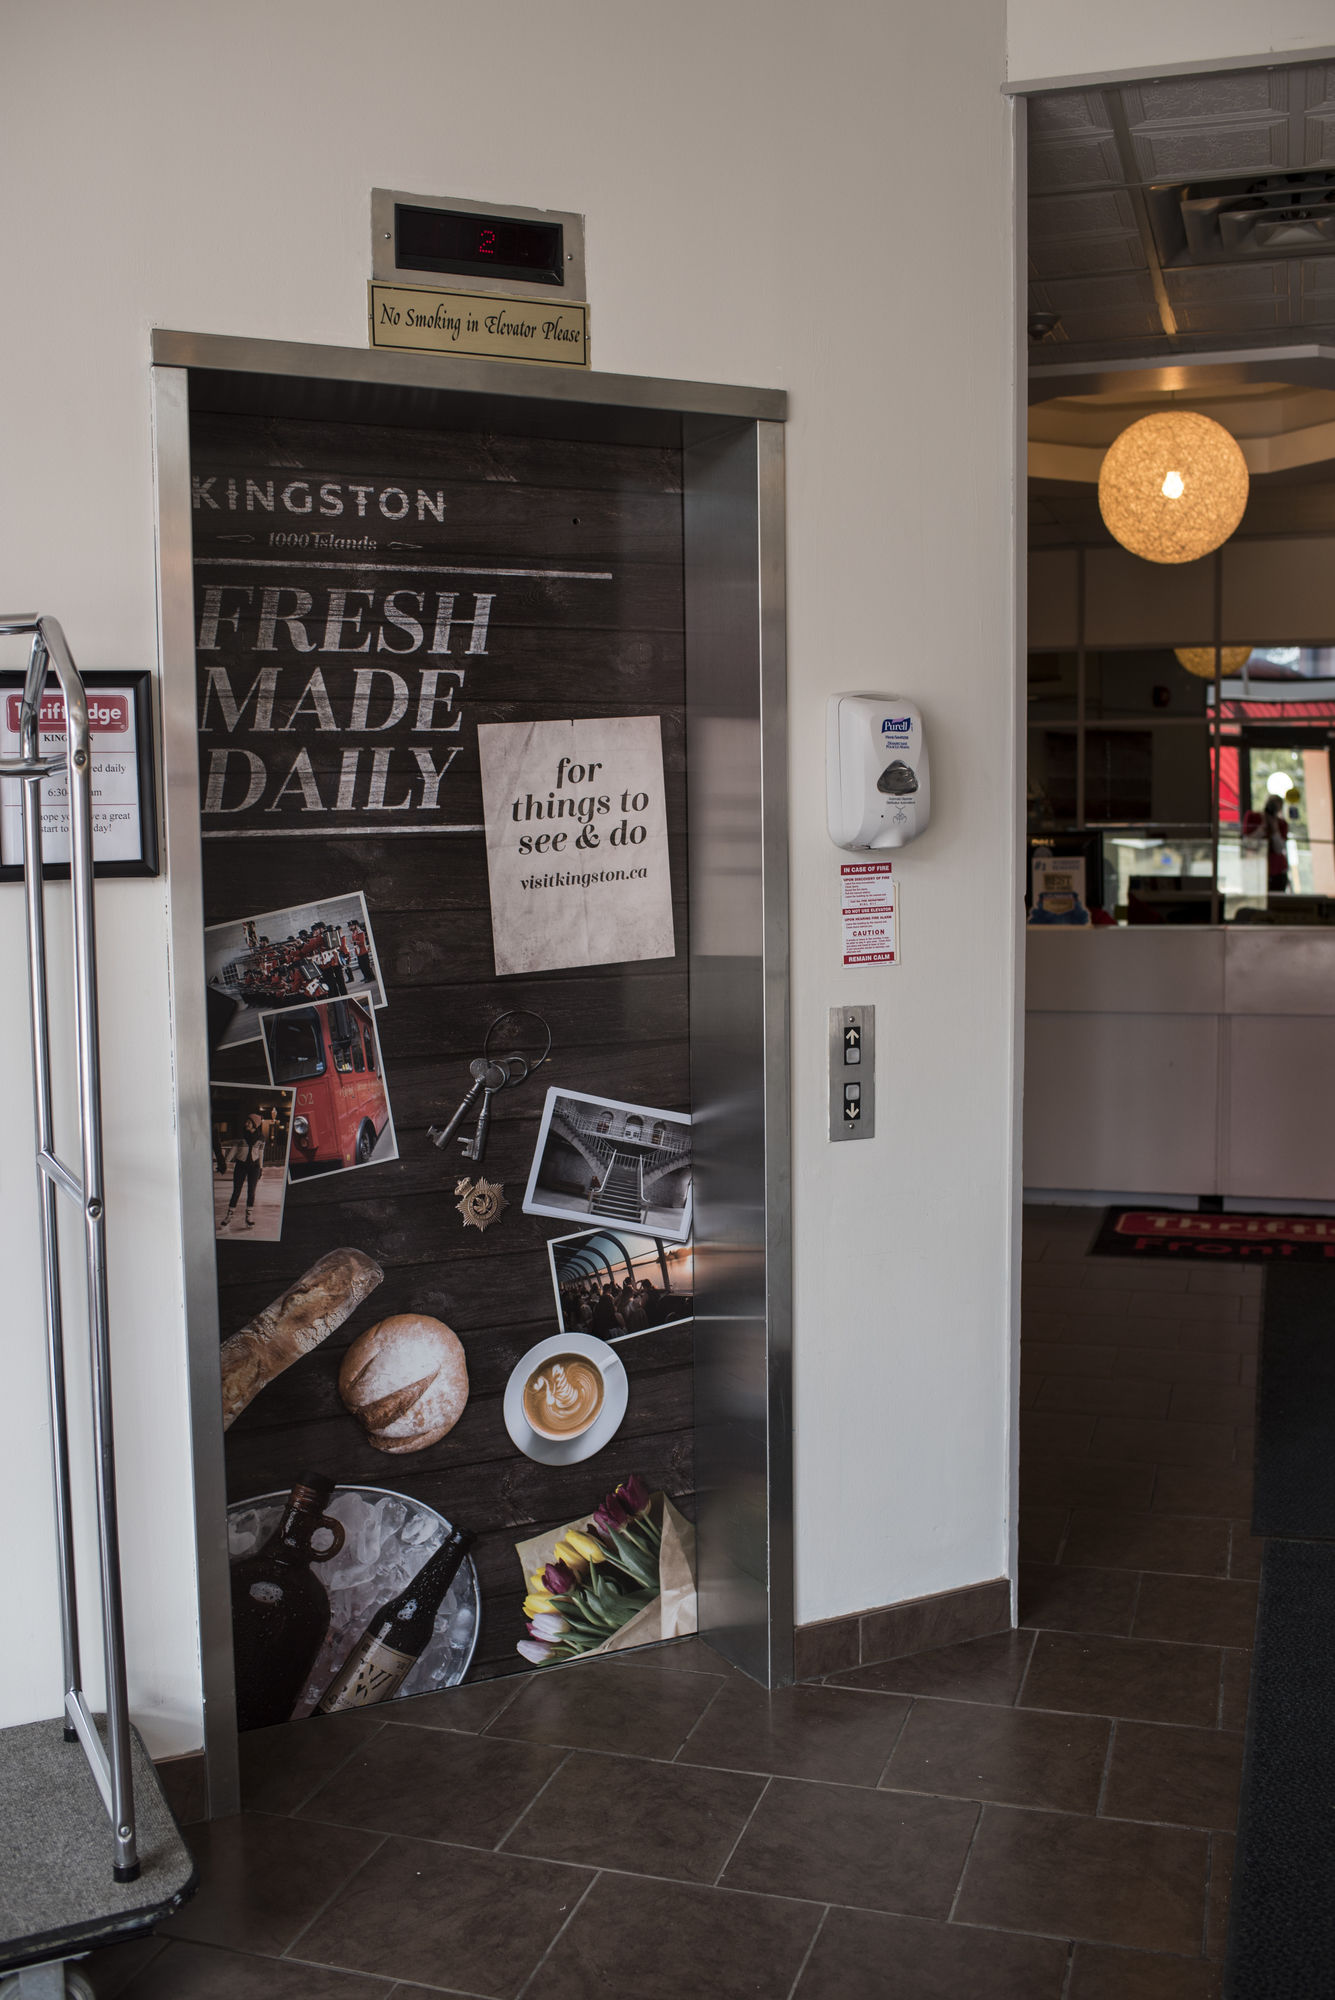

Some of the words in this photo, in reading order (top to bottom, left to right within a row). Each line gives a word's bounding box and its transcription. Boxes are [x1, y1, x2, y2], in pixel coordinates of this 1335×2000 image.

[479, 229, 495, 254] 2
[380, 303, 401, 326] No
[405, 303, 461, 341] Smoking
[466, 312, 479, 332] in
[484, 310, 537, 338] Elevator
[541, 316, 580, 343] Please
[192, 476, 446, 522] KINGSTON
[268, 532, 309, 548] 1000
[312, 532, 377, 551] Islands
[195, 585, 496, 655] FRESH
[198, 666, 465, 732] MADE
[884, 721, 908, 731] Purell
[105, 763, 126, 774] daily
[201, 746, 464, 813] DAILY
[556, 757, 603, 789] for
[109, 812, 131, 822] great
[512, 792, 611, 824] things
[620, 788, 649, 813] to
[60, 825, 69, 833] to
[93, 824, 112, 834] day!
[518, 831, 568, 855] see
[575, 823, 601, 850] &
[609, 819, 647, 846] do
[520, 867, 648, 890] visitkingston.ca
[852, 929, 885, 937] CAUTION
[848, 955, 872, 963] REMAIN
[873, 953, 890, 961] CALM
[1135, 1237, 1299, 1256] Front
